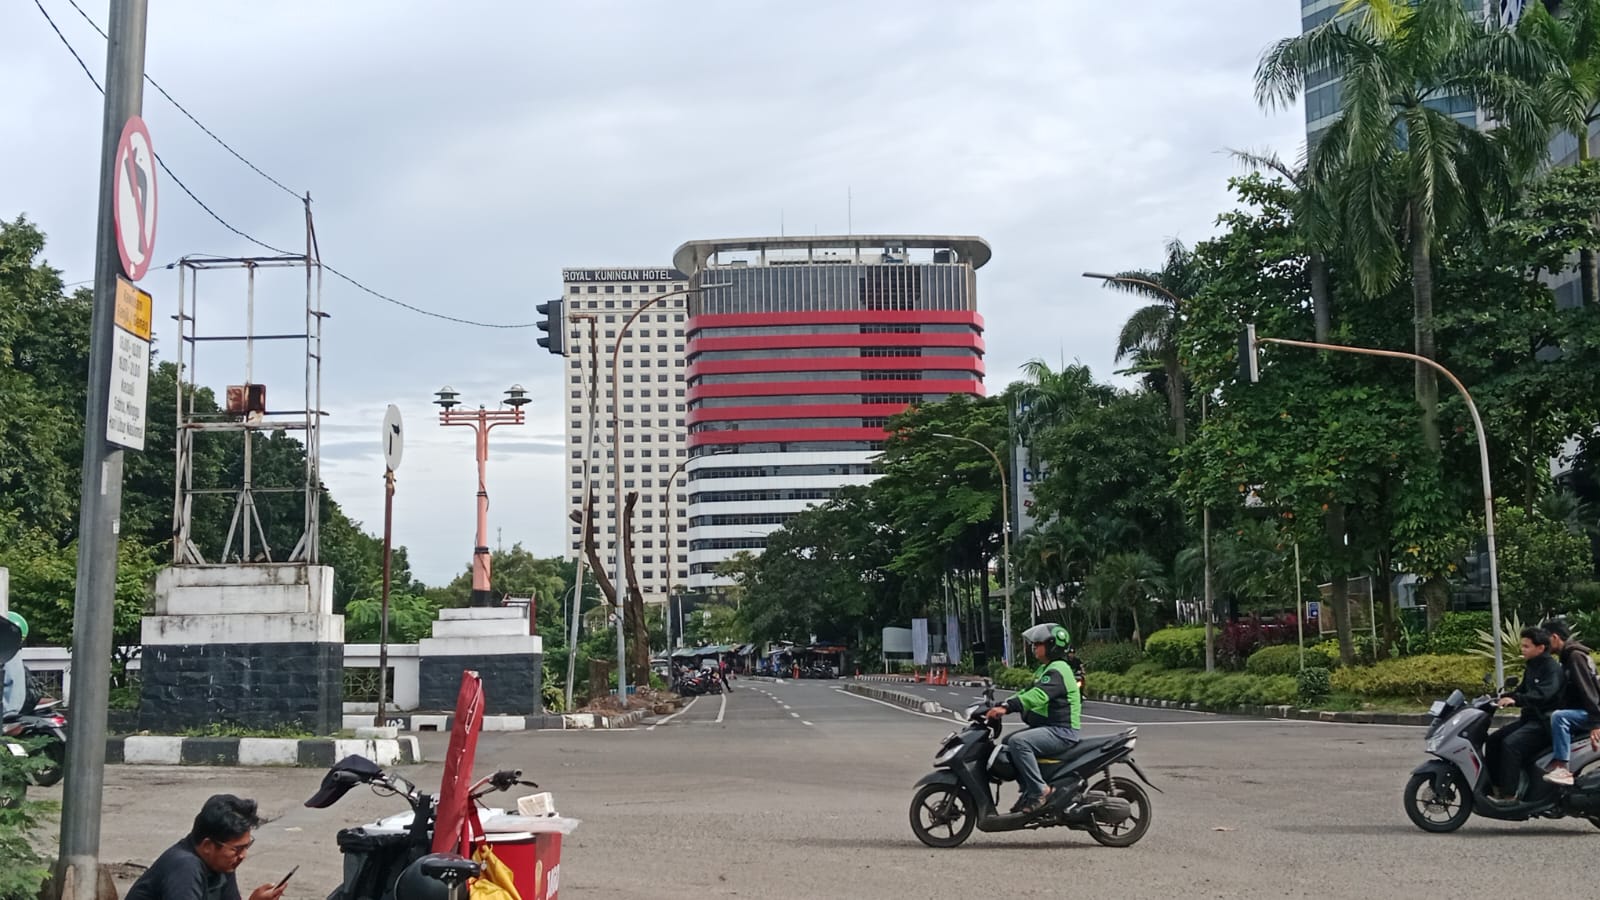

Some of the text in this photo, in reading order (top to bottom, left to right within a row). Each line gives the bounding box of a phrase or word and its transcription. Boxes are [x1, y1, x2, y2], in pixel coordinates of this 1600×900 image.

[563, 270, 673, 281] ROYAL KUNINGAN HOTEL
